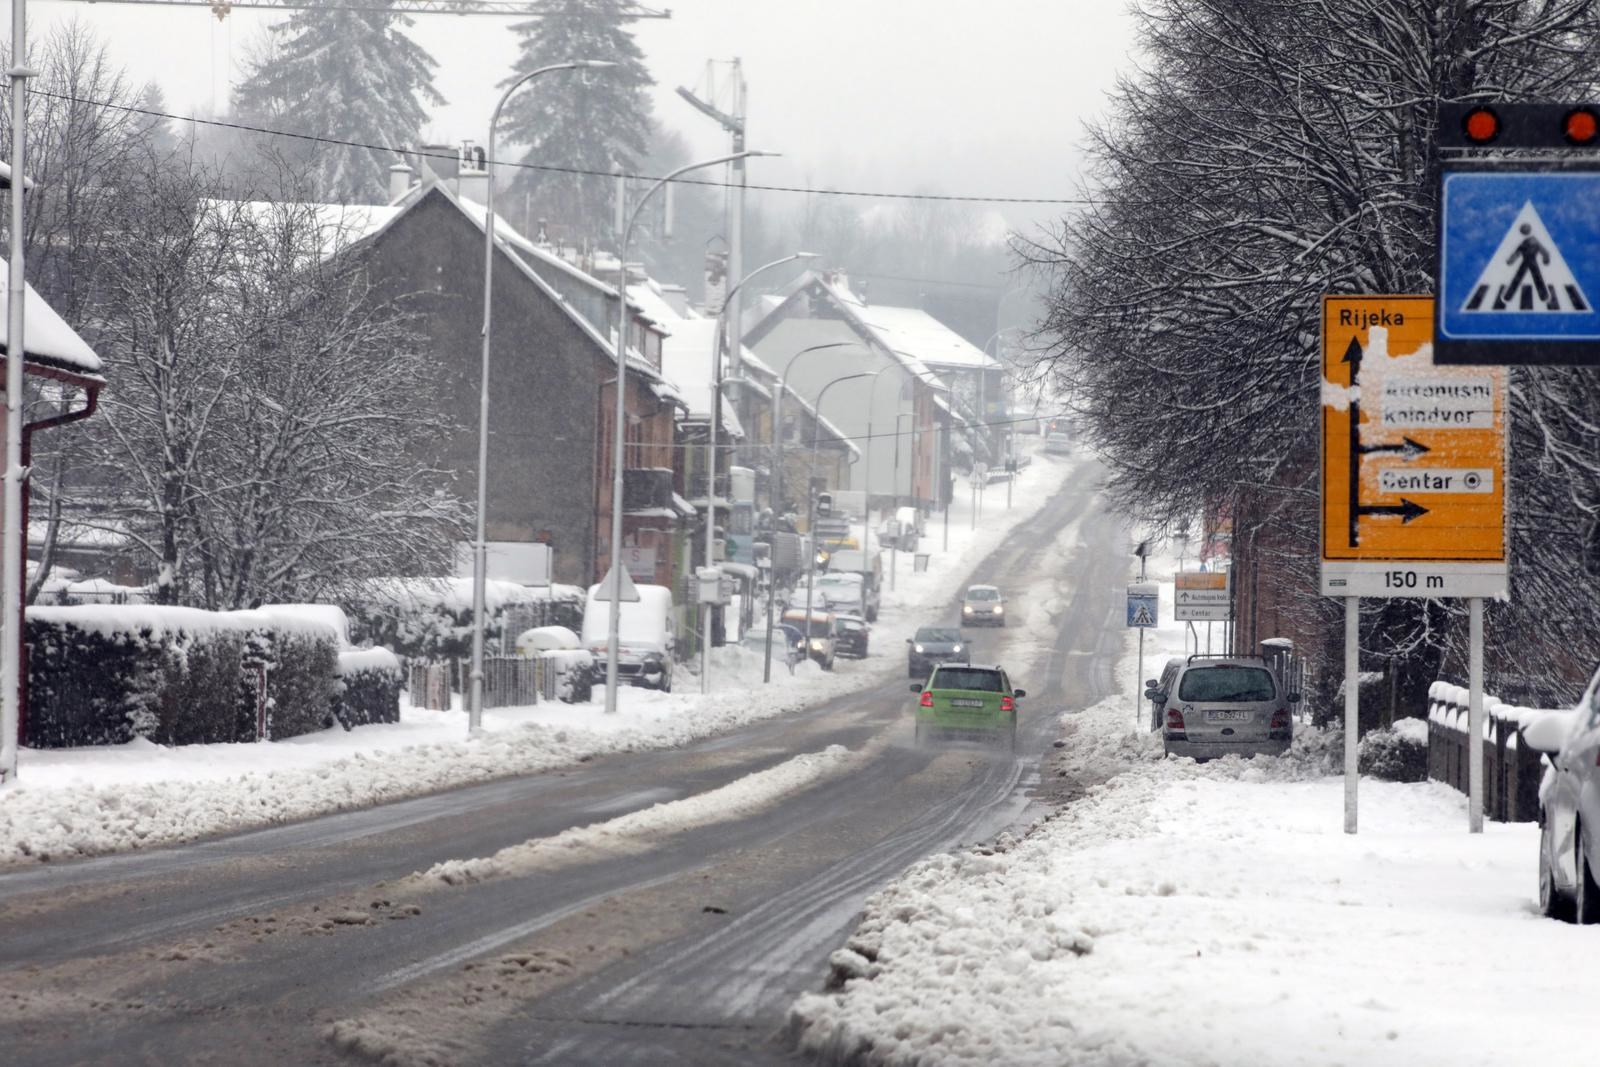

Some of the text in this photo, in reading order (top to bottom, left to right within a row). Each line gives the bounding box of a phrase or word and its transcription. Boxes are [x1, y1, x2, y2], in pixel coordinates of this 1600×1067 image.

[1340, 309, 1404, 330] Rijeka
[1383, 472, 1452, 489] Centar
[1385, 571, 1444, 588] 150 m
